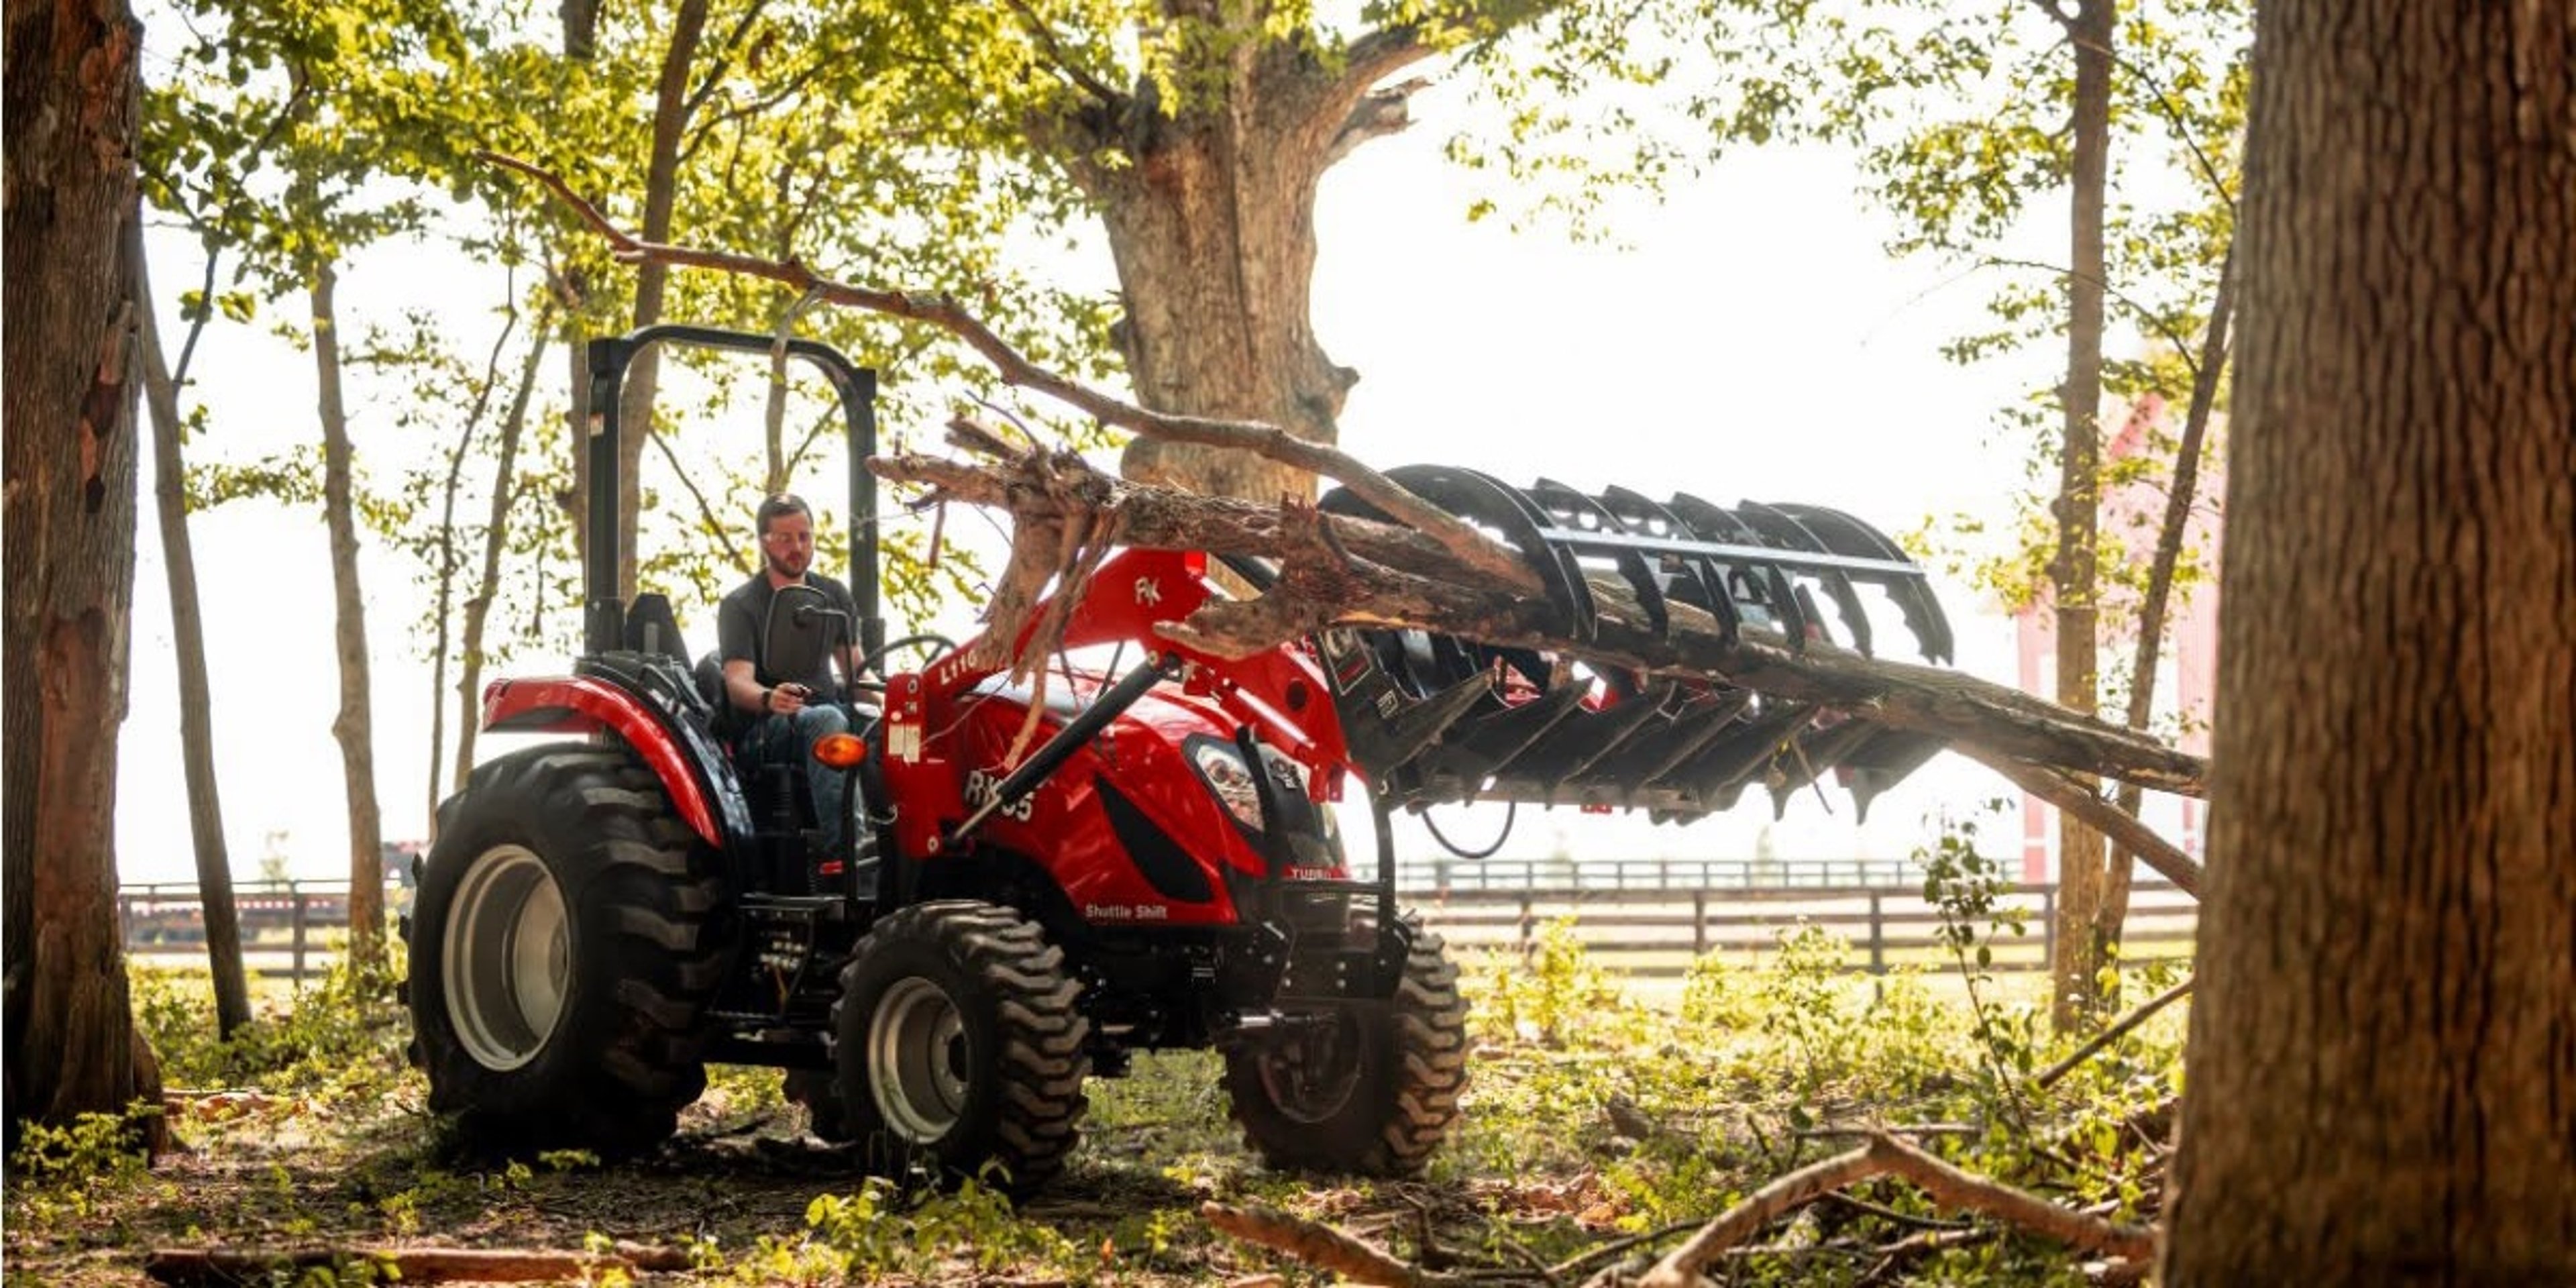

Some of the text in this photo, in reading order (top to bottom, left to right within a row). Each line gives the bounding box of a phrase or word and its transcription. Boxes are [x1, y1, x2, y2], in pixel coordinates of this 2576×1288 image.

[965, 769, 1034, 822] RK5
[1085, 903, 1168, 920] Shuttle Shift
